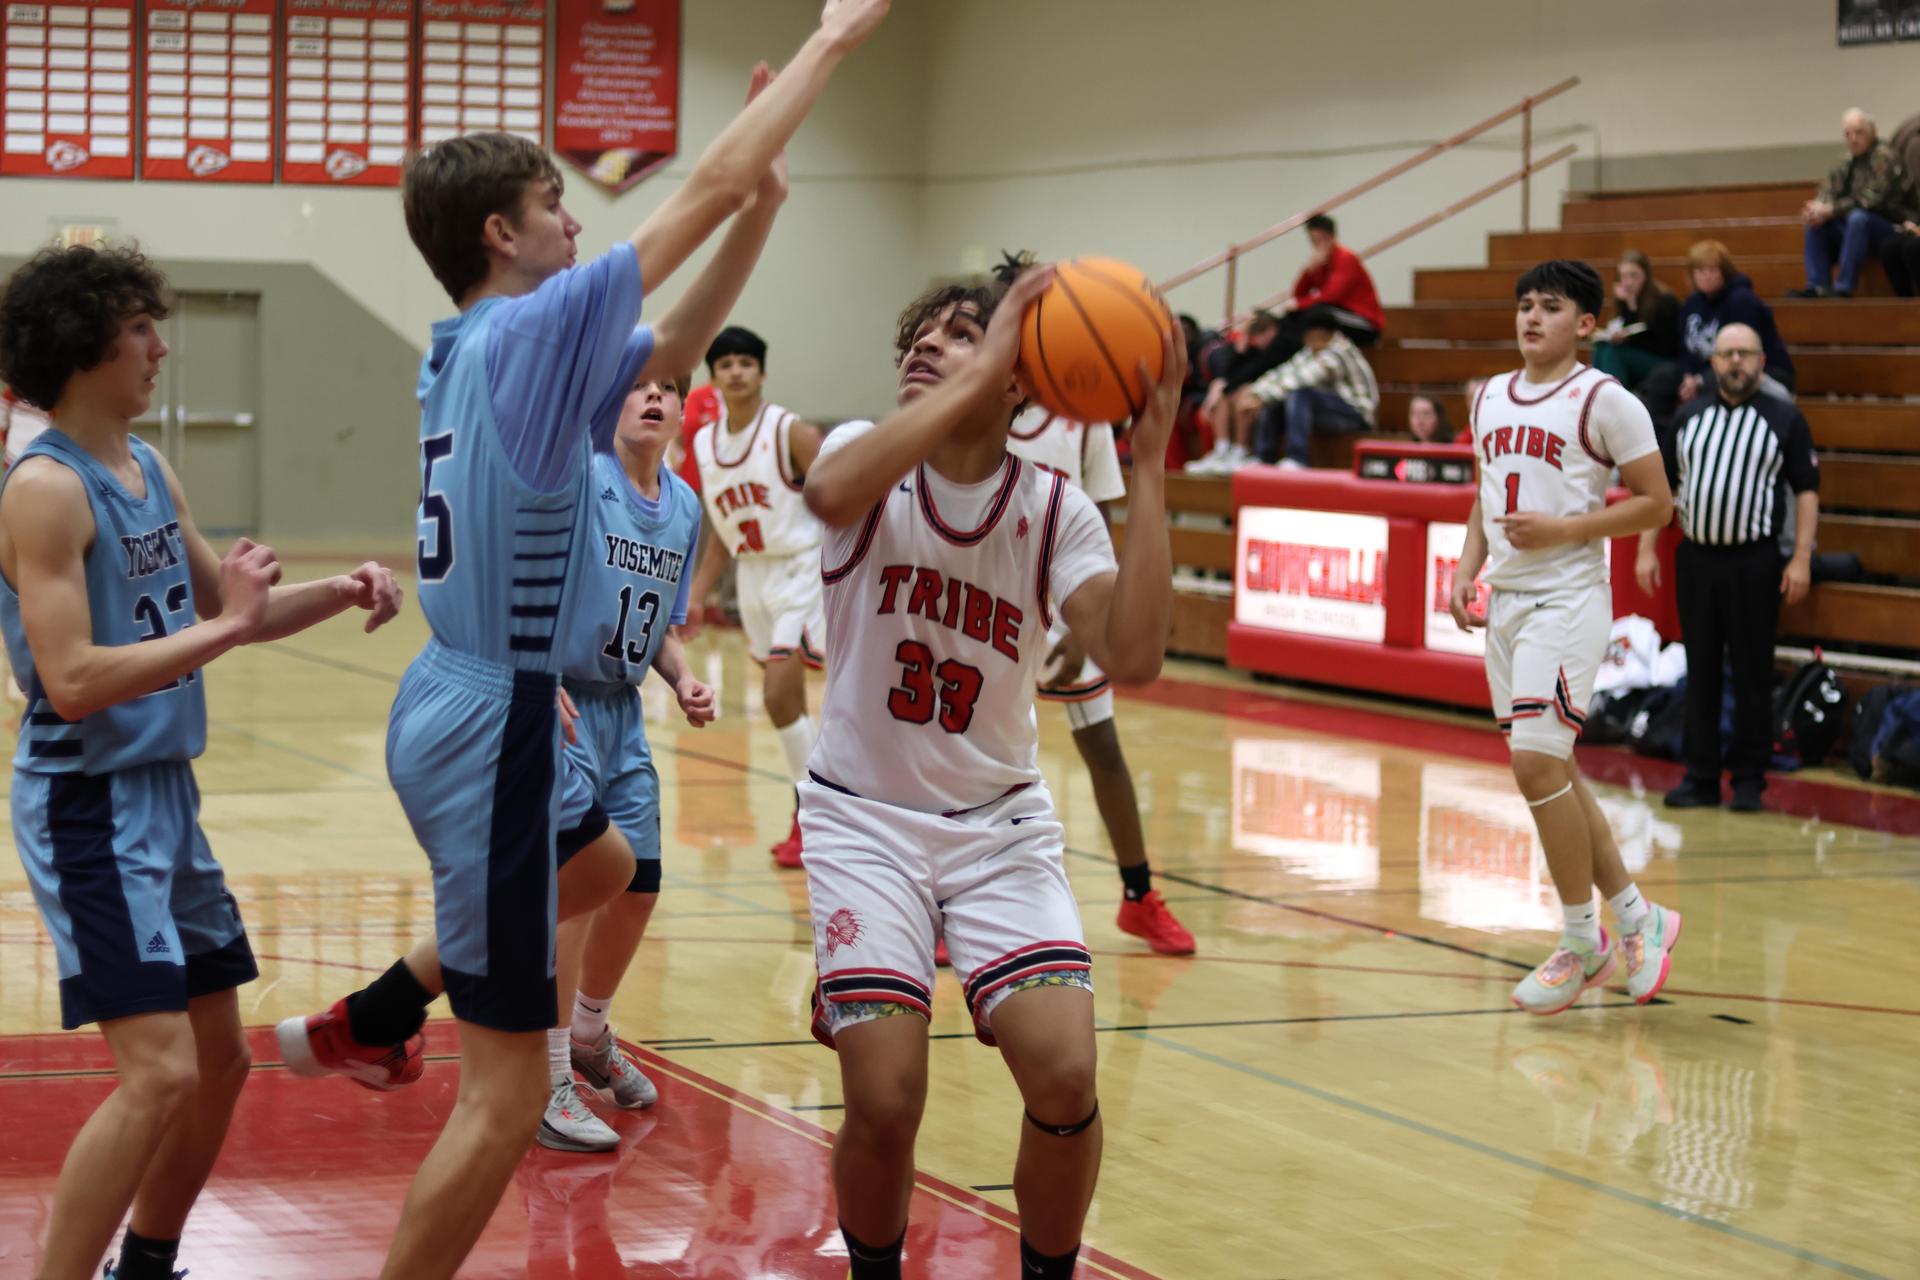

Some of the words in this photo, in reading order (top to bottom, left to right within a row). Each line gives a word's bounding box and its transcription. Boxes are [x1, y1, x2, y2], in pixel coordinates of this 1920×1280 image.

[1482, 424, 1567, 472] TRIBE
[1504, 472, 1521, 515] 1
[605, 533, 683, 584] YOSEMITE
[602, 584, 661, 667] 13
[877, 565, 1023, 664] TRIBE
[887, 639, 985, 734] 33
